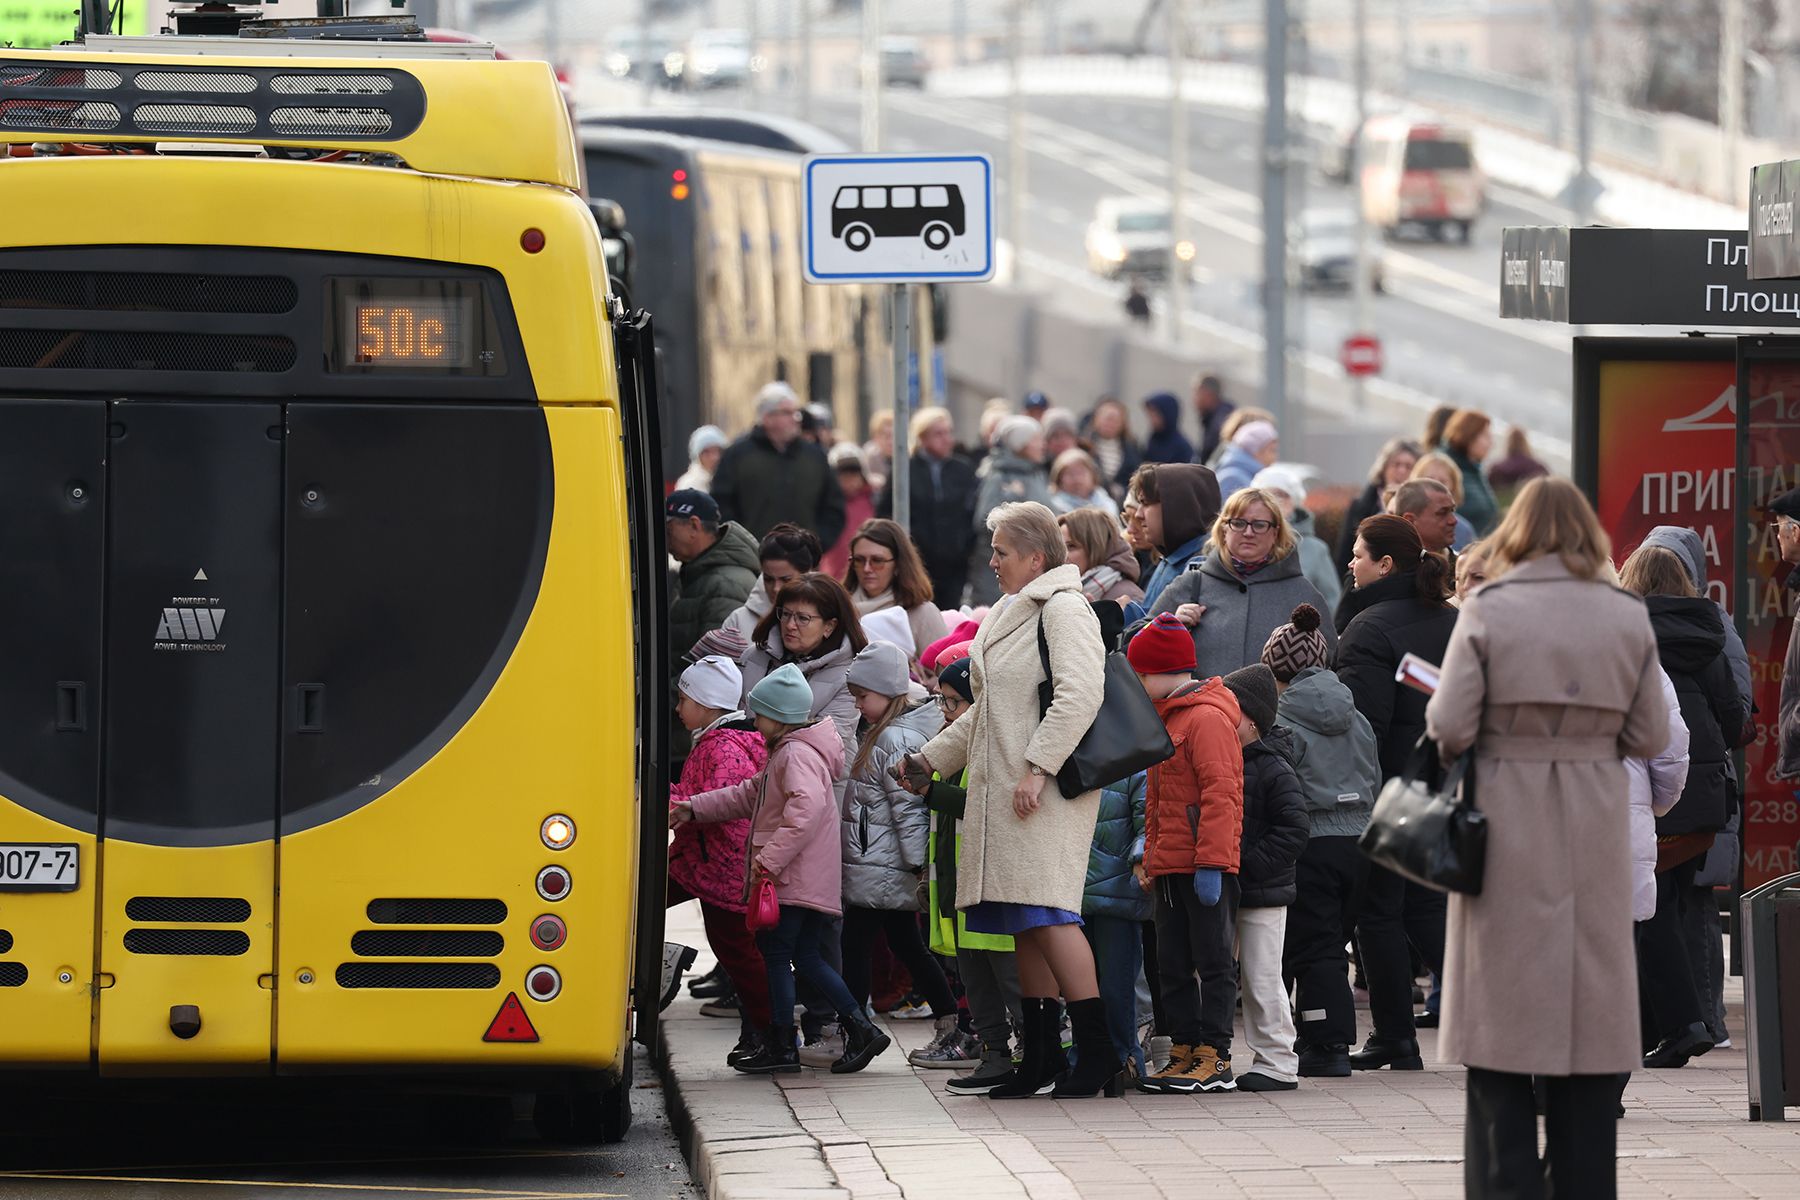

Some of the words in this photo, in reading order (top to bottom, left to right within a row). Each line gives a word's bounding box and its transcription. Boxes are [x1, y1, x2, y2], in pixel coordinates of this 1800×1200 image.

[1705, 285, 1800, 318] Площ
[1642, 463, 1800, 515] ПРИГЛА
[172, 596, 208, 605] POWERED
[210, 597, 220, 605] BY
